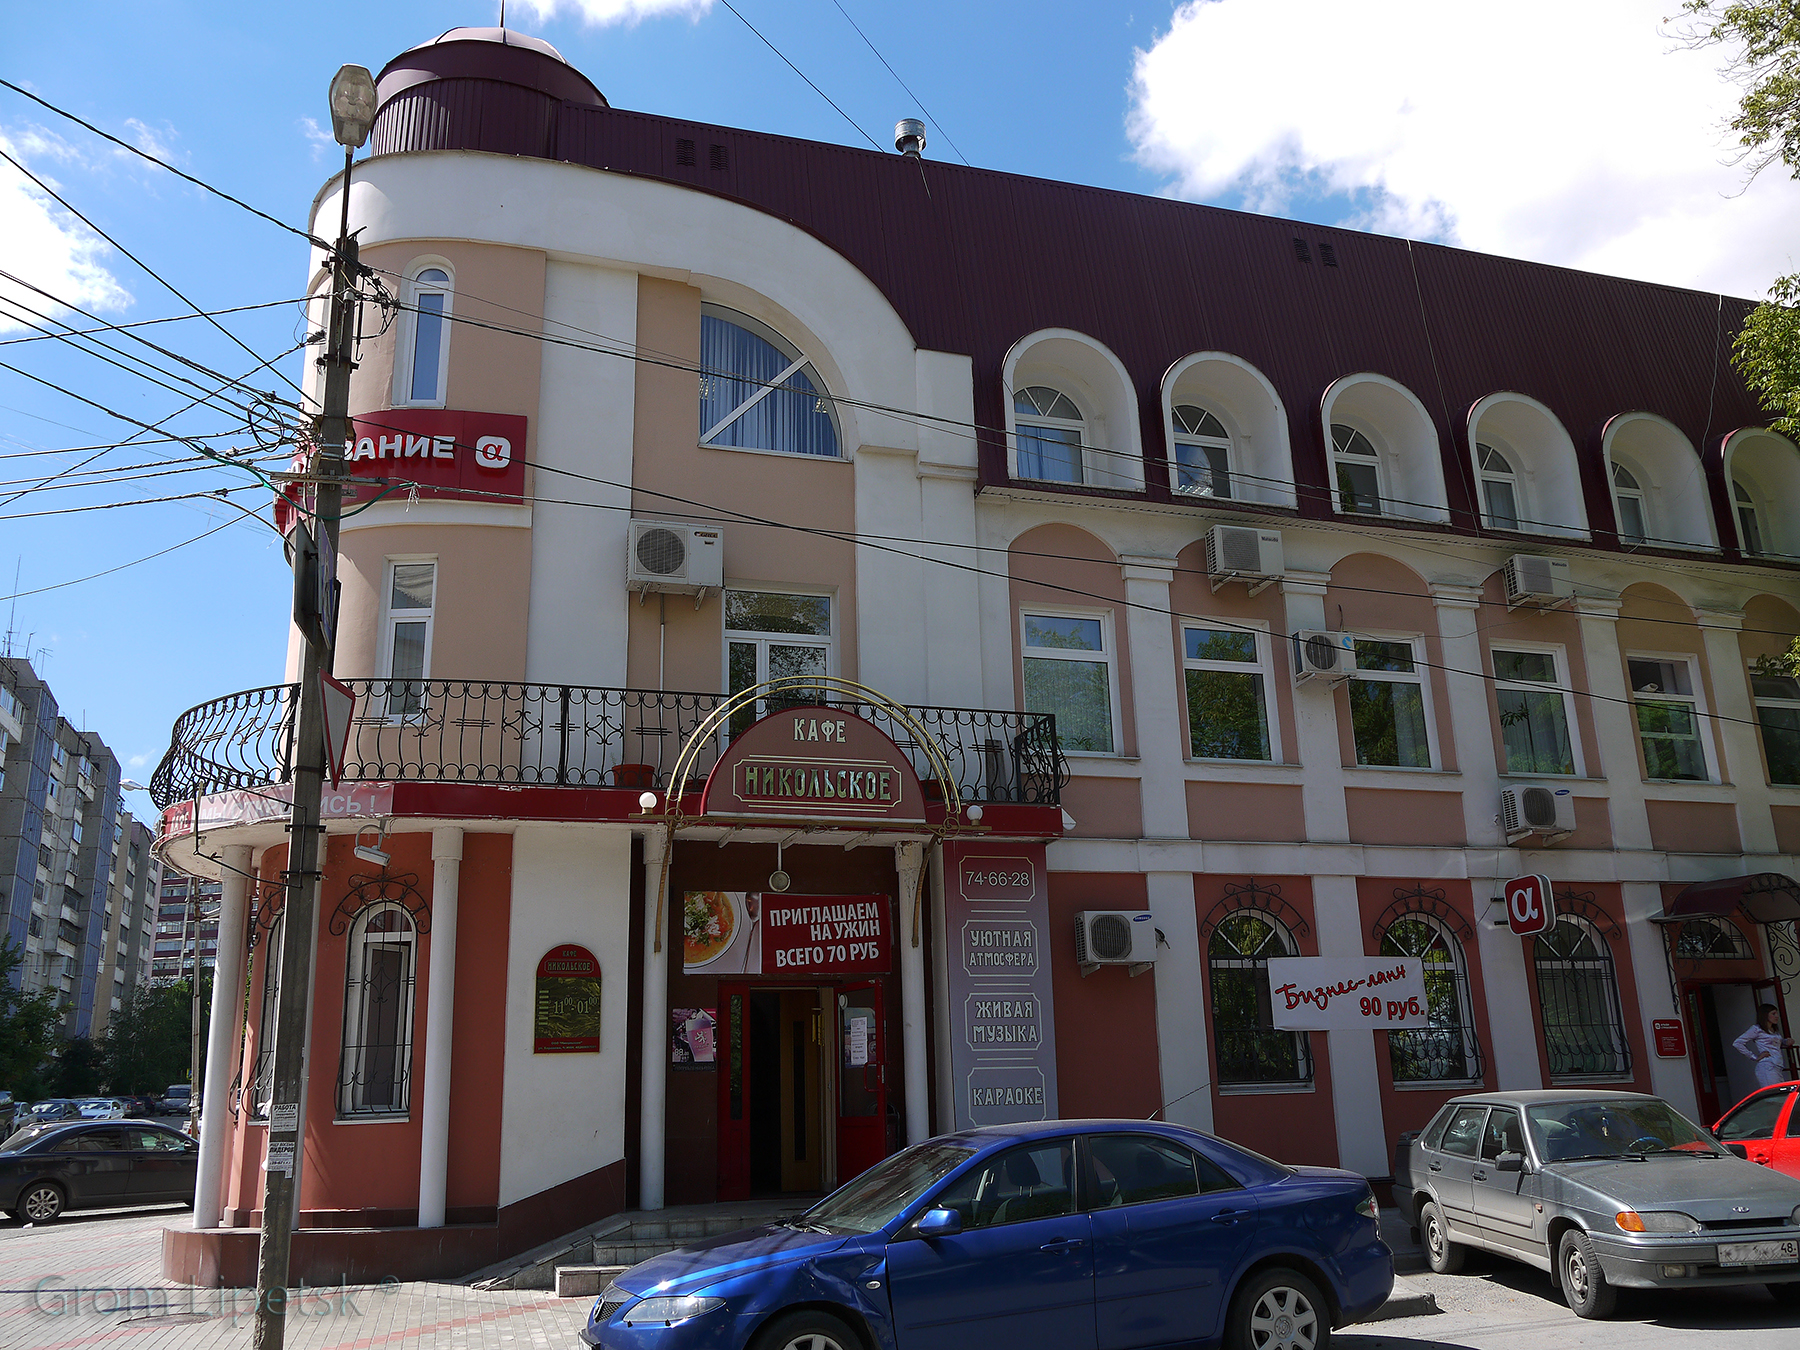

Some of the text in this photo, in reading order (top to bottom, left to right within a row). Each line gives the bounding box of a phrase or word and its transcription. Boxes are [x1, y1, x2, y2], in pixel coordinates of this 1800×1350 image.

[794, 718, 847, 743] КАФЕ
[744, 766, 892, 800] НИКОЛЬСКОЕ
[965, 871, 1030, 886] 74-66-28
[769, 902, 879, 926] ПРИГЛАШАЕМ
[810, 919, 880, 941] НА УЖИН
[970, 930, 1033, 947] УЮТНАЯ
[775, 941, 879, 967] ВСЕГО 70 РУБ
[969, 952, 1035, 966] АТМОСФЕРА
[547, 962, 591, 971] НИКОЛЬСКОЕ
[975, 1001, 1034, 1018] ЖИВАЯ
[1360, 996, 1425, 1020] 90 руб.
[972, 1025, 1038, 1042] МУЗЫКА
[972, 1087, 1043, 1106] КАРАОКЕ
[1781, 1242, 1793, 1253] 48
